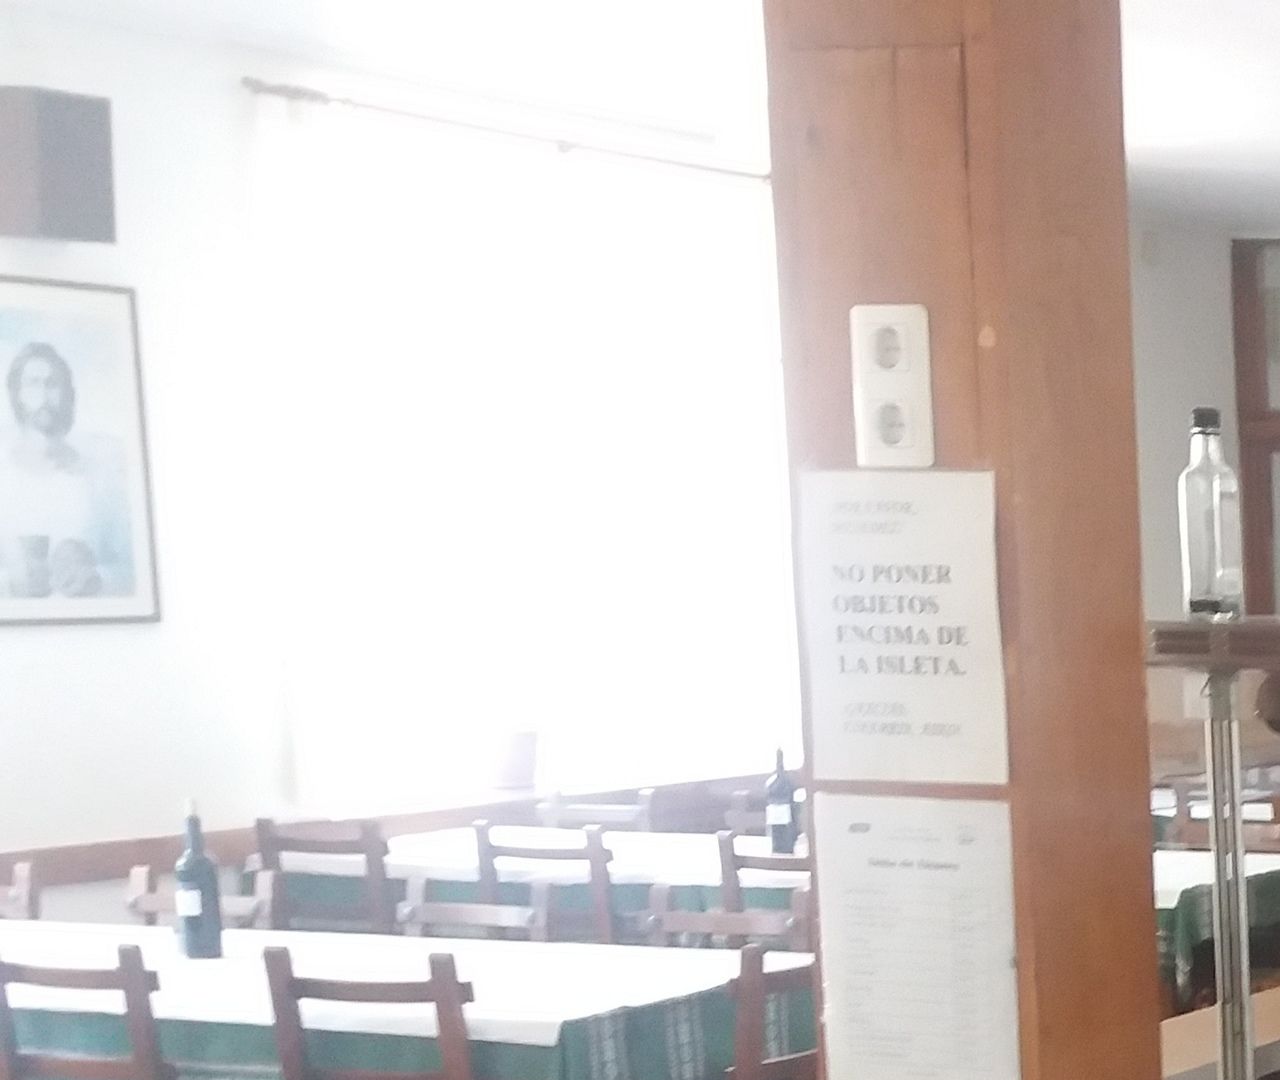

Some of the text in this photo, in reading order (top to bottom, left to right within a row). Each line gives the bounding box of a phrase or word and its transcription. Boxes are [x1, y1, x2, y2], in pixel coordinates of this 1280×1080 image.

[832, 564, 952, 585] NO PONER
[832, 594, 940, 614] OBJETOS
[836, 624, 970, 647] ENCIMA DE
[839, 655, 870, 674] LA
